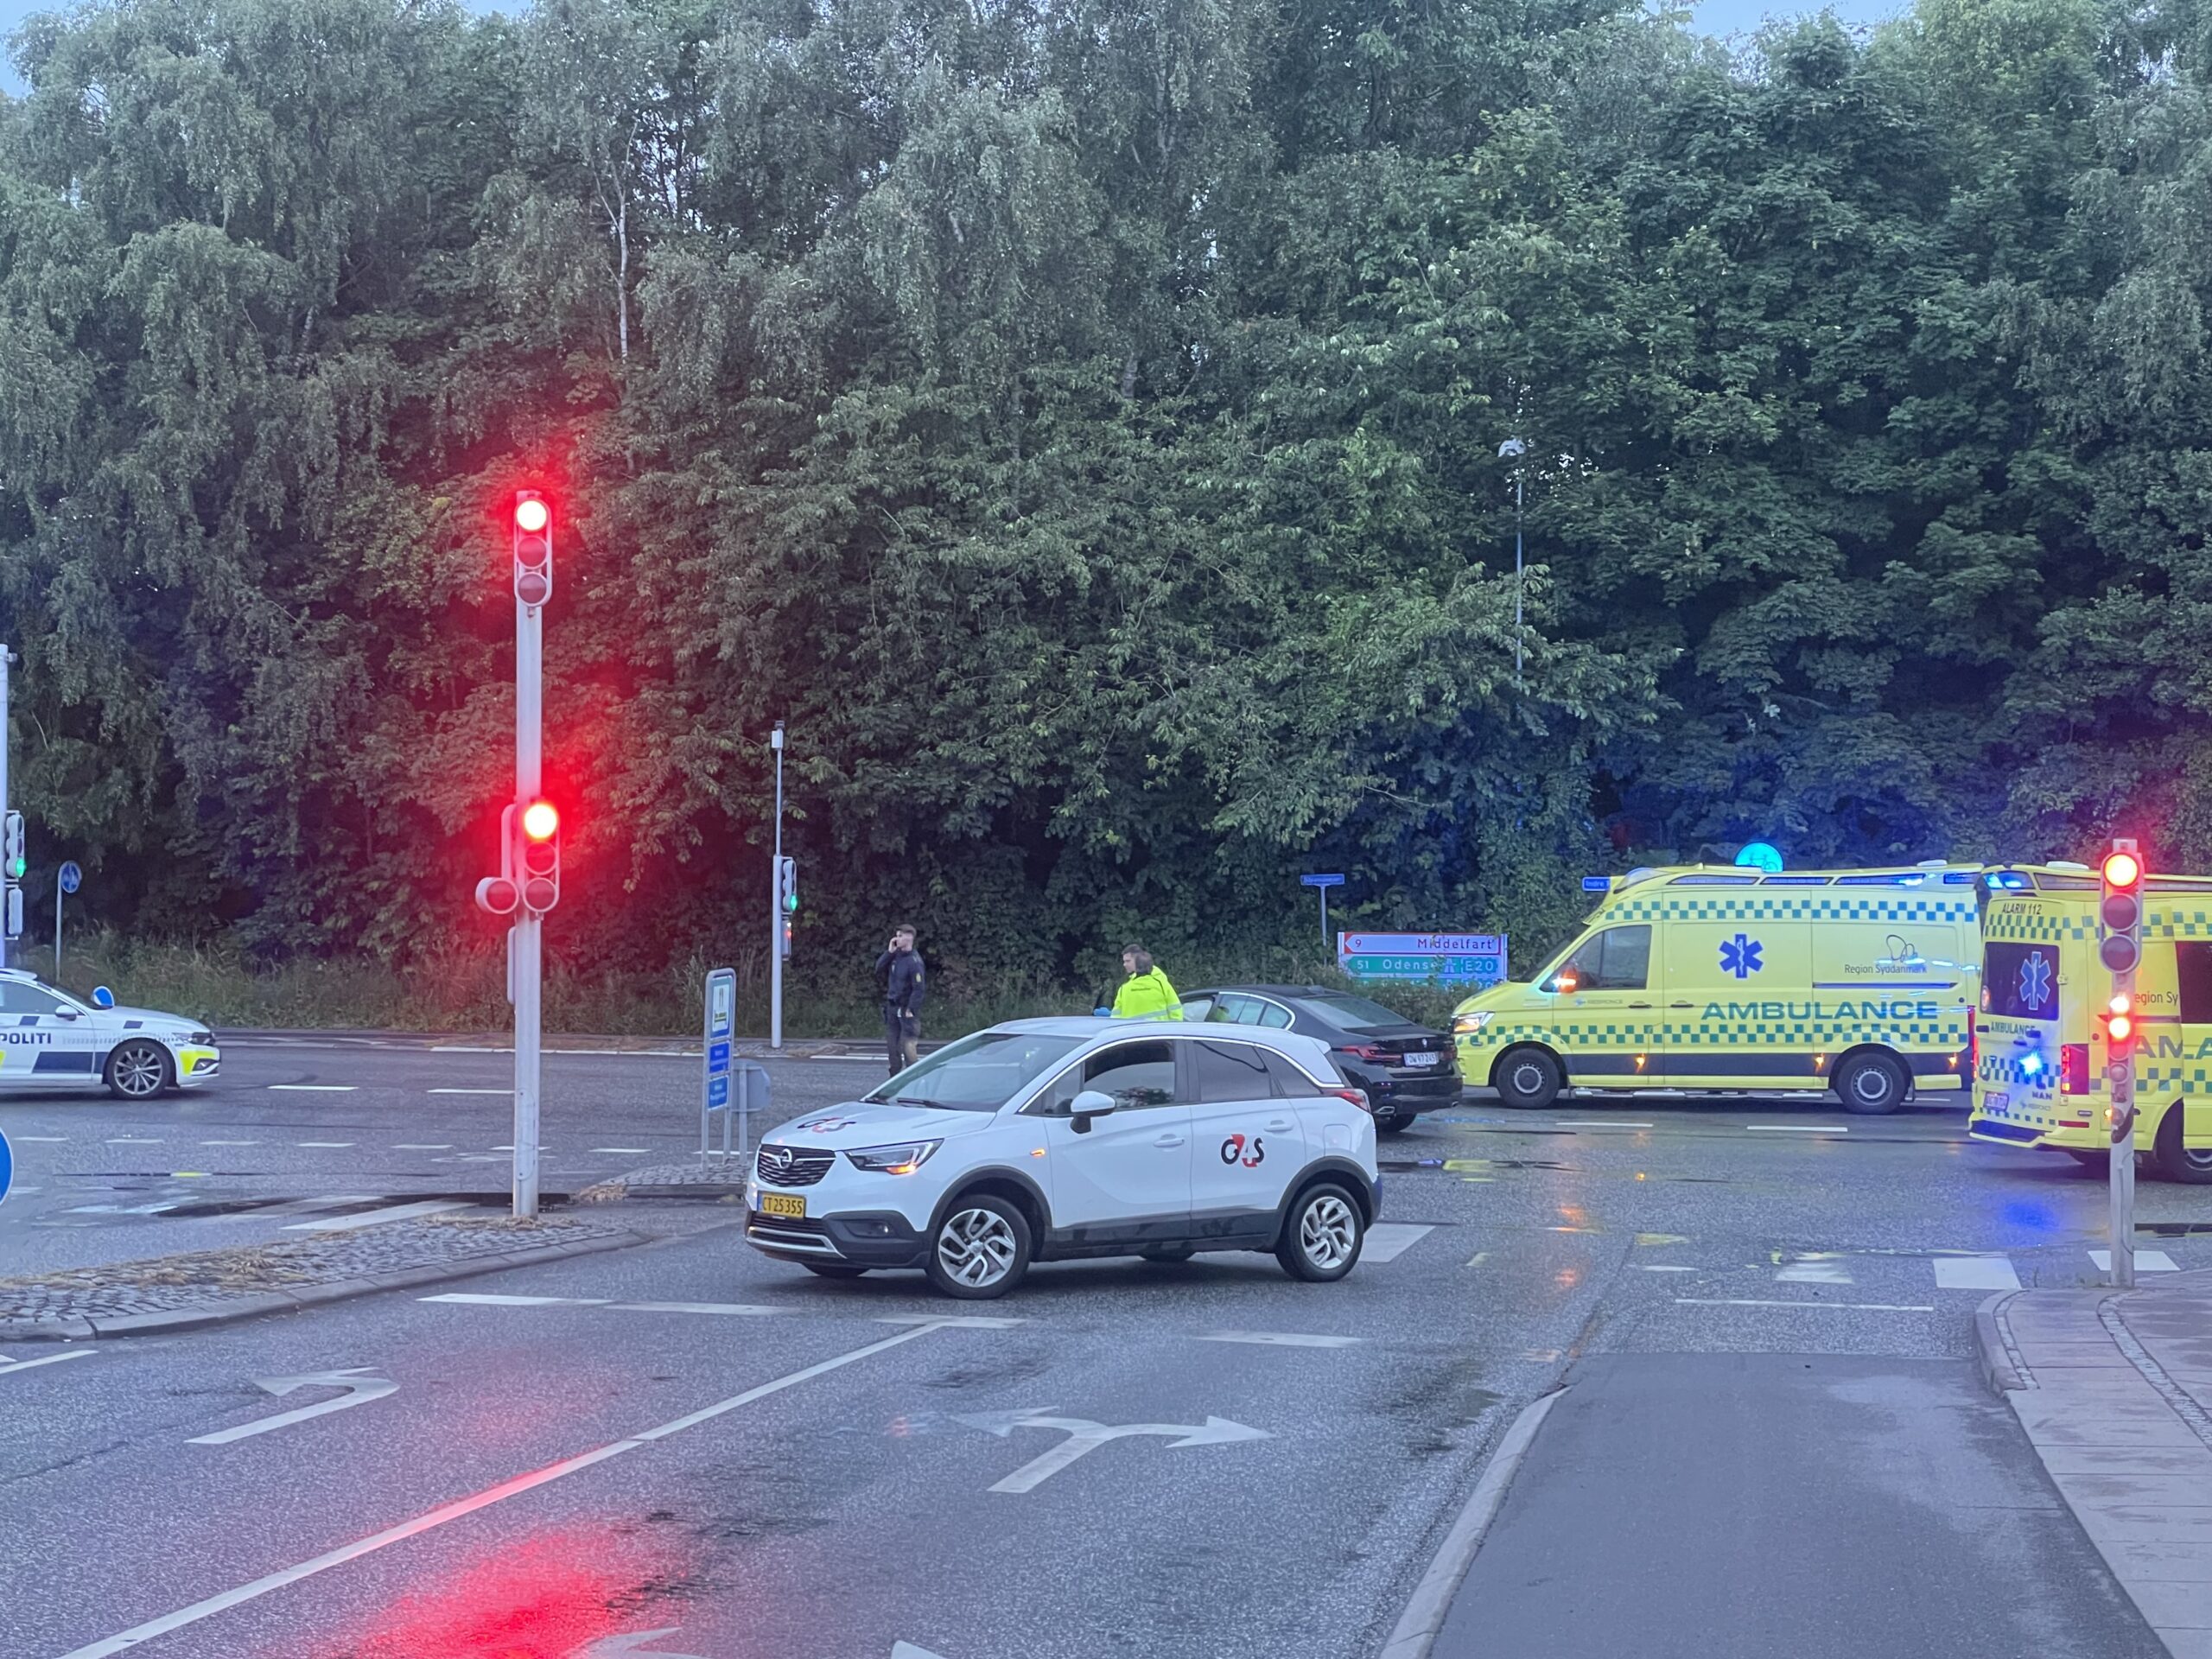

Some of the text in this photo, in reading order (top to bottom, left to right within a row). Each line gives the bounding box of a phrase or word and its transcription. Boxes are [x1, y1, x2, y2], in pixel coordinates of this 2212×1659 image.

[2002, 903, 2043, 915] ALARM 112
[1355, 938, 1362, 948] 9
[1357, 960, 1370, 969] 51
[1465, 960, 1494, 971] E20
[1844, 963, 1873, 975] Region
[2134, 991, 2164, 1006] egion
[1700, 1001, 1938, 1020] AMBULANCE
[0, 1033, 51, 1044] POLITI
[2031, 1090, 2053, 1100] MAN
[1220, 1134, 1265, 1168] G4S
